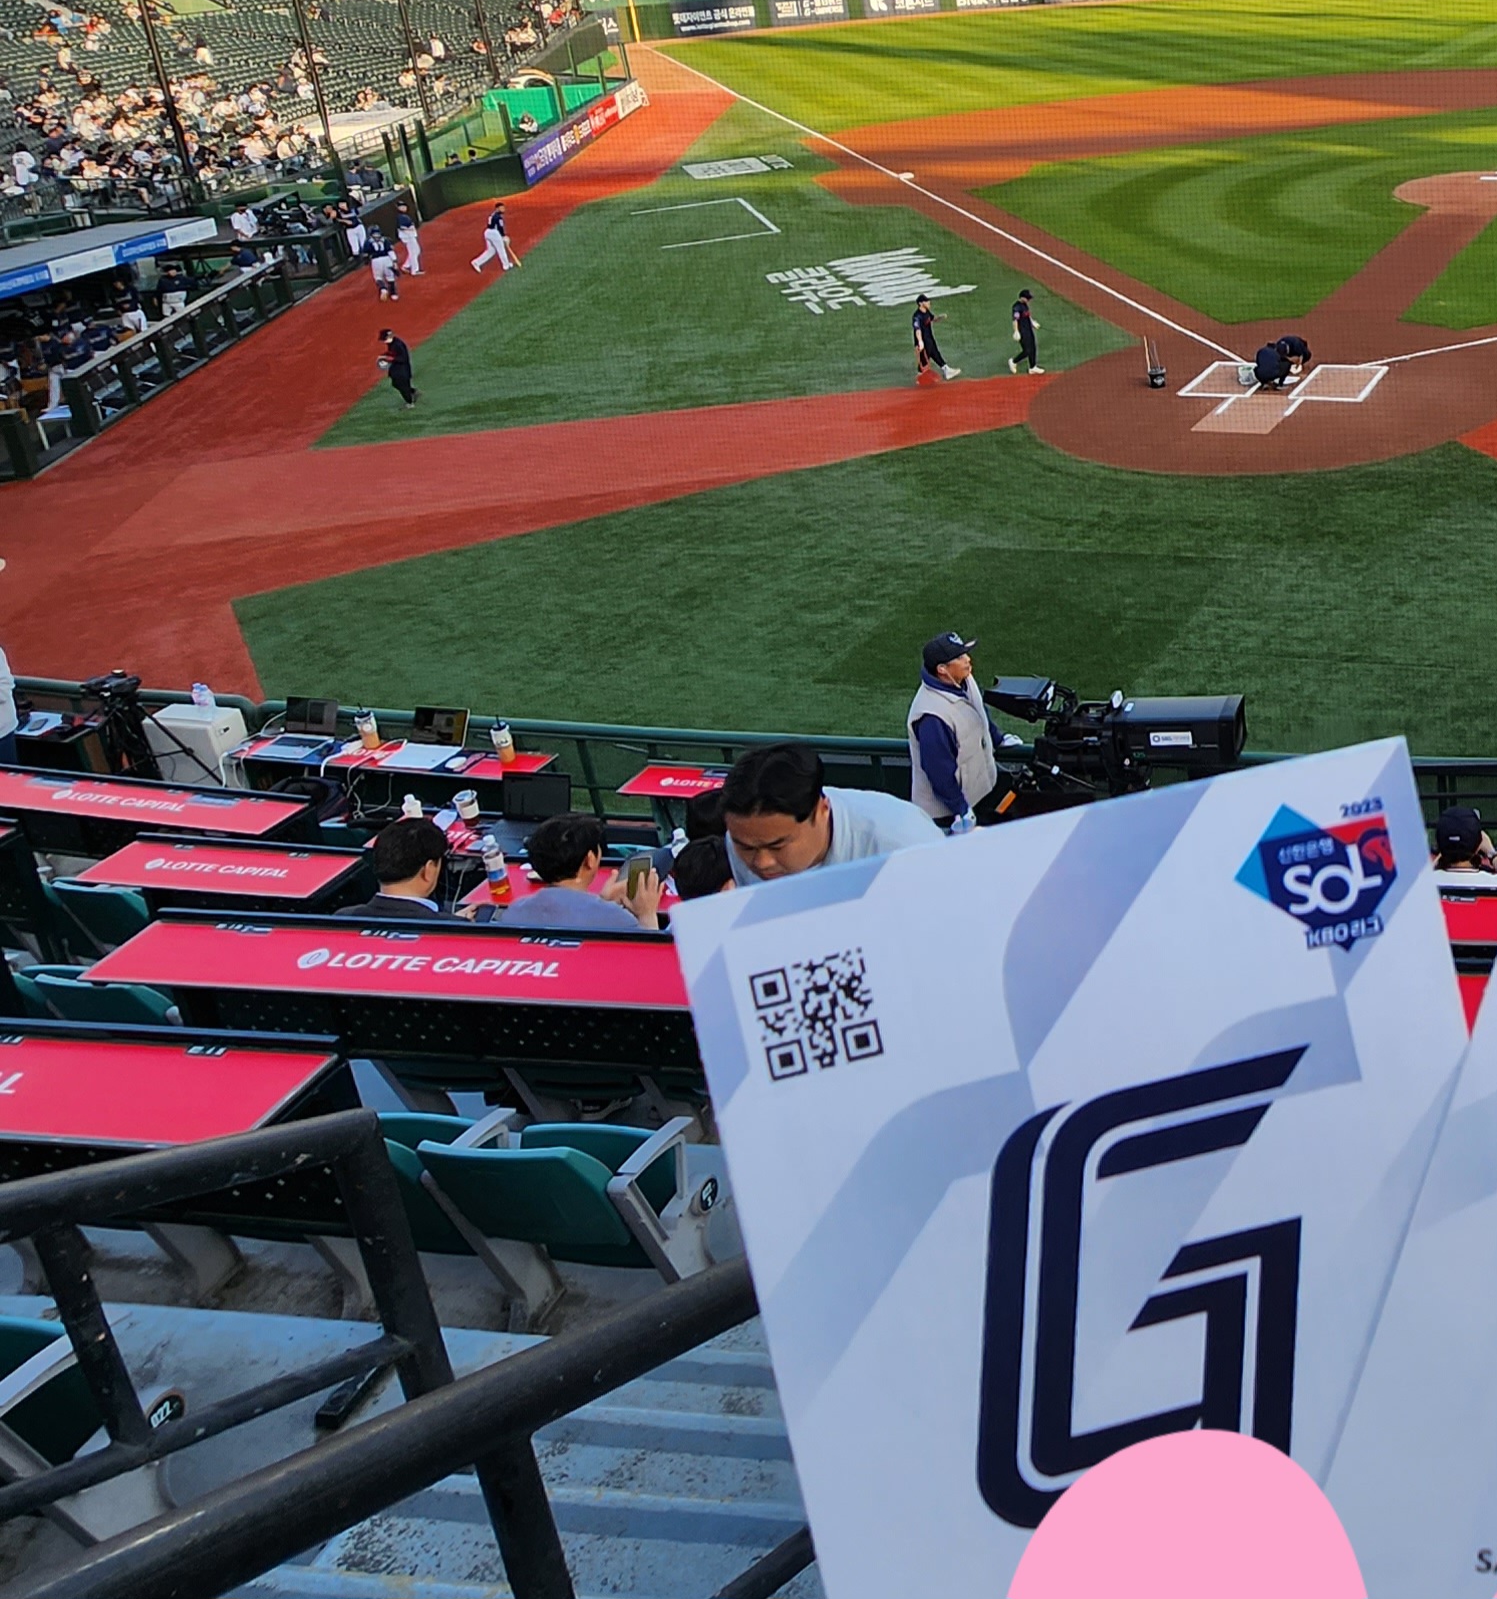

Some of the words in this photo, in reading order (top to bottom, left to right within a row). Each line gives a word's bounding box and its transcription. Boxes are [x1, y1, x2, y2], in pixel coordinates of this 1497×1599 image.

[68, 791, 117, 804] LOTTE
[119, 795, 185, 813] CAPITAL
[1340, 797, 1383, 818] 2023
[161, 860, 216, 874] LOTTE
[221, 864, 288, 879] CAPITAL
[326, 951, 427, 973] LOTTE
[432, 956, 560, 978] CAPITAL
